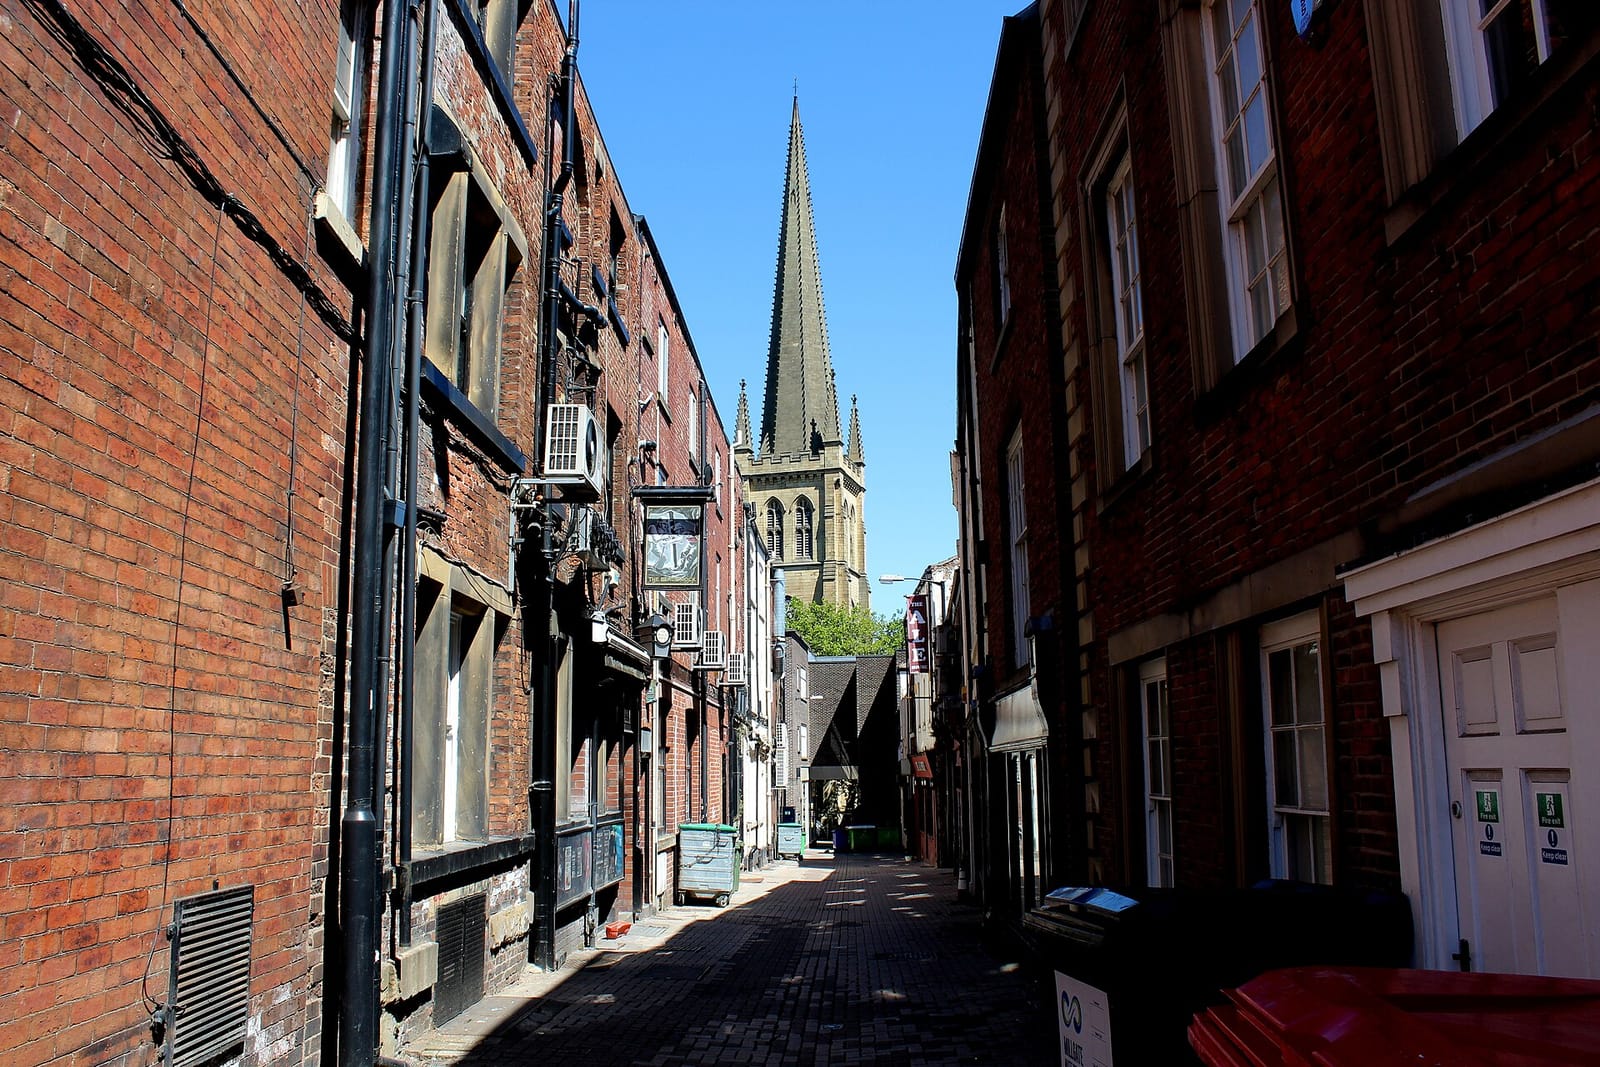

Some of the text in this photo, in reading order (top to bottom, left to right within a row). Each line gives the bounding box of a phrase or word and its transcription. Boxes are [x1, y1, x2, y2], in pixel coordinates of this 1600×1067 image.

[909, 609, 926, 662] ALE
[1541, 816, 1561, 825] Fire exit
[1542, 851, 1567, 861] Keep clear
